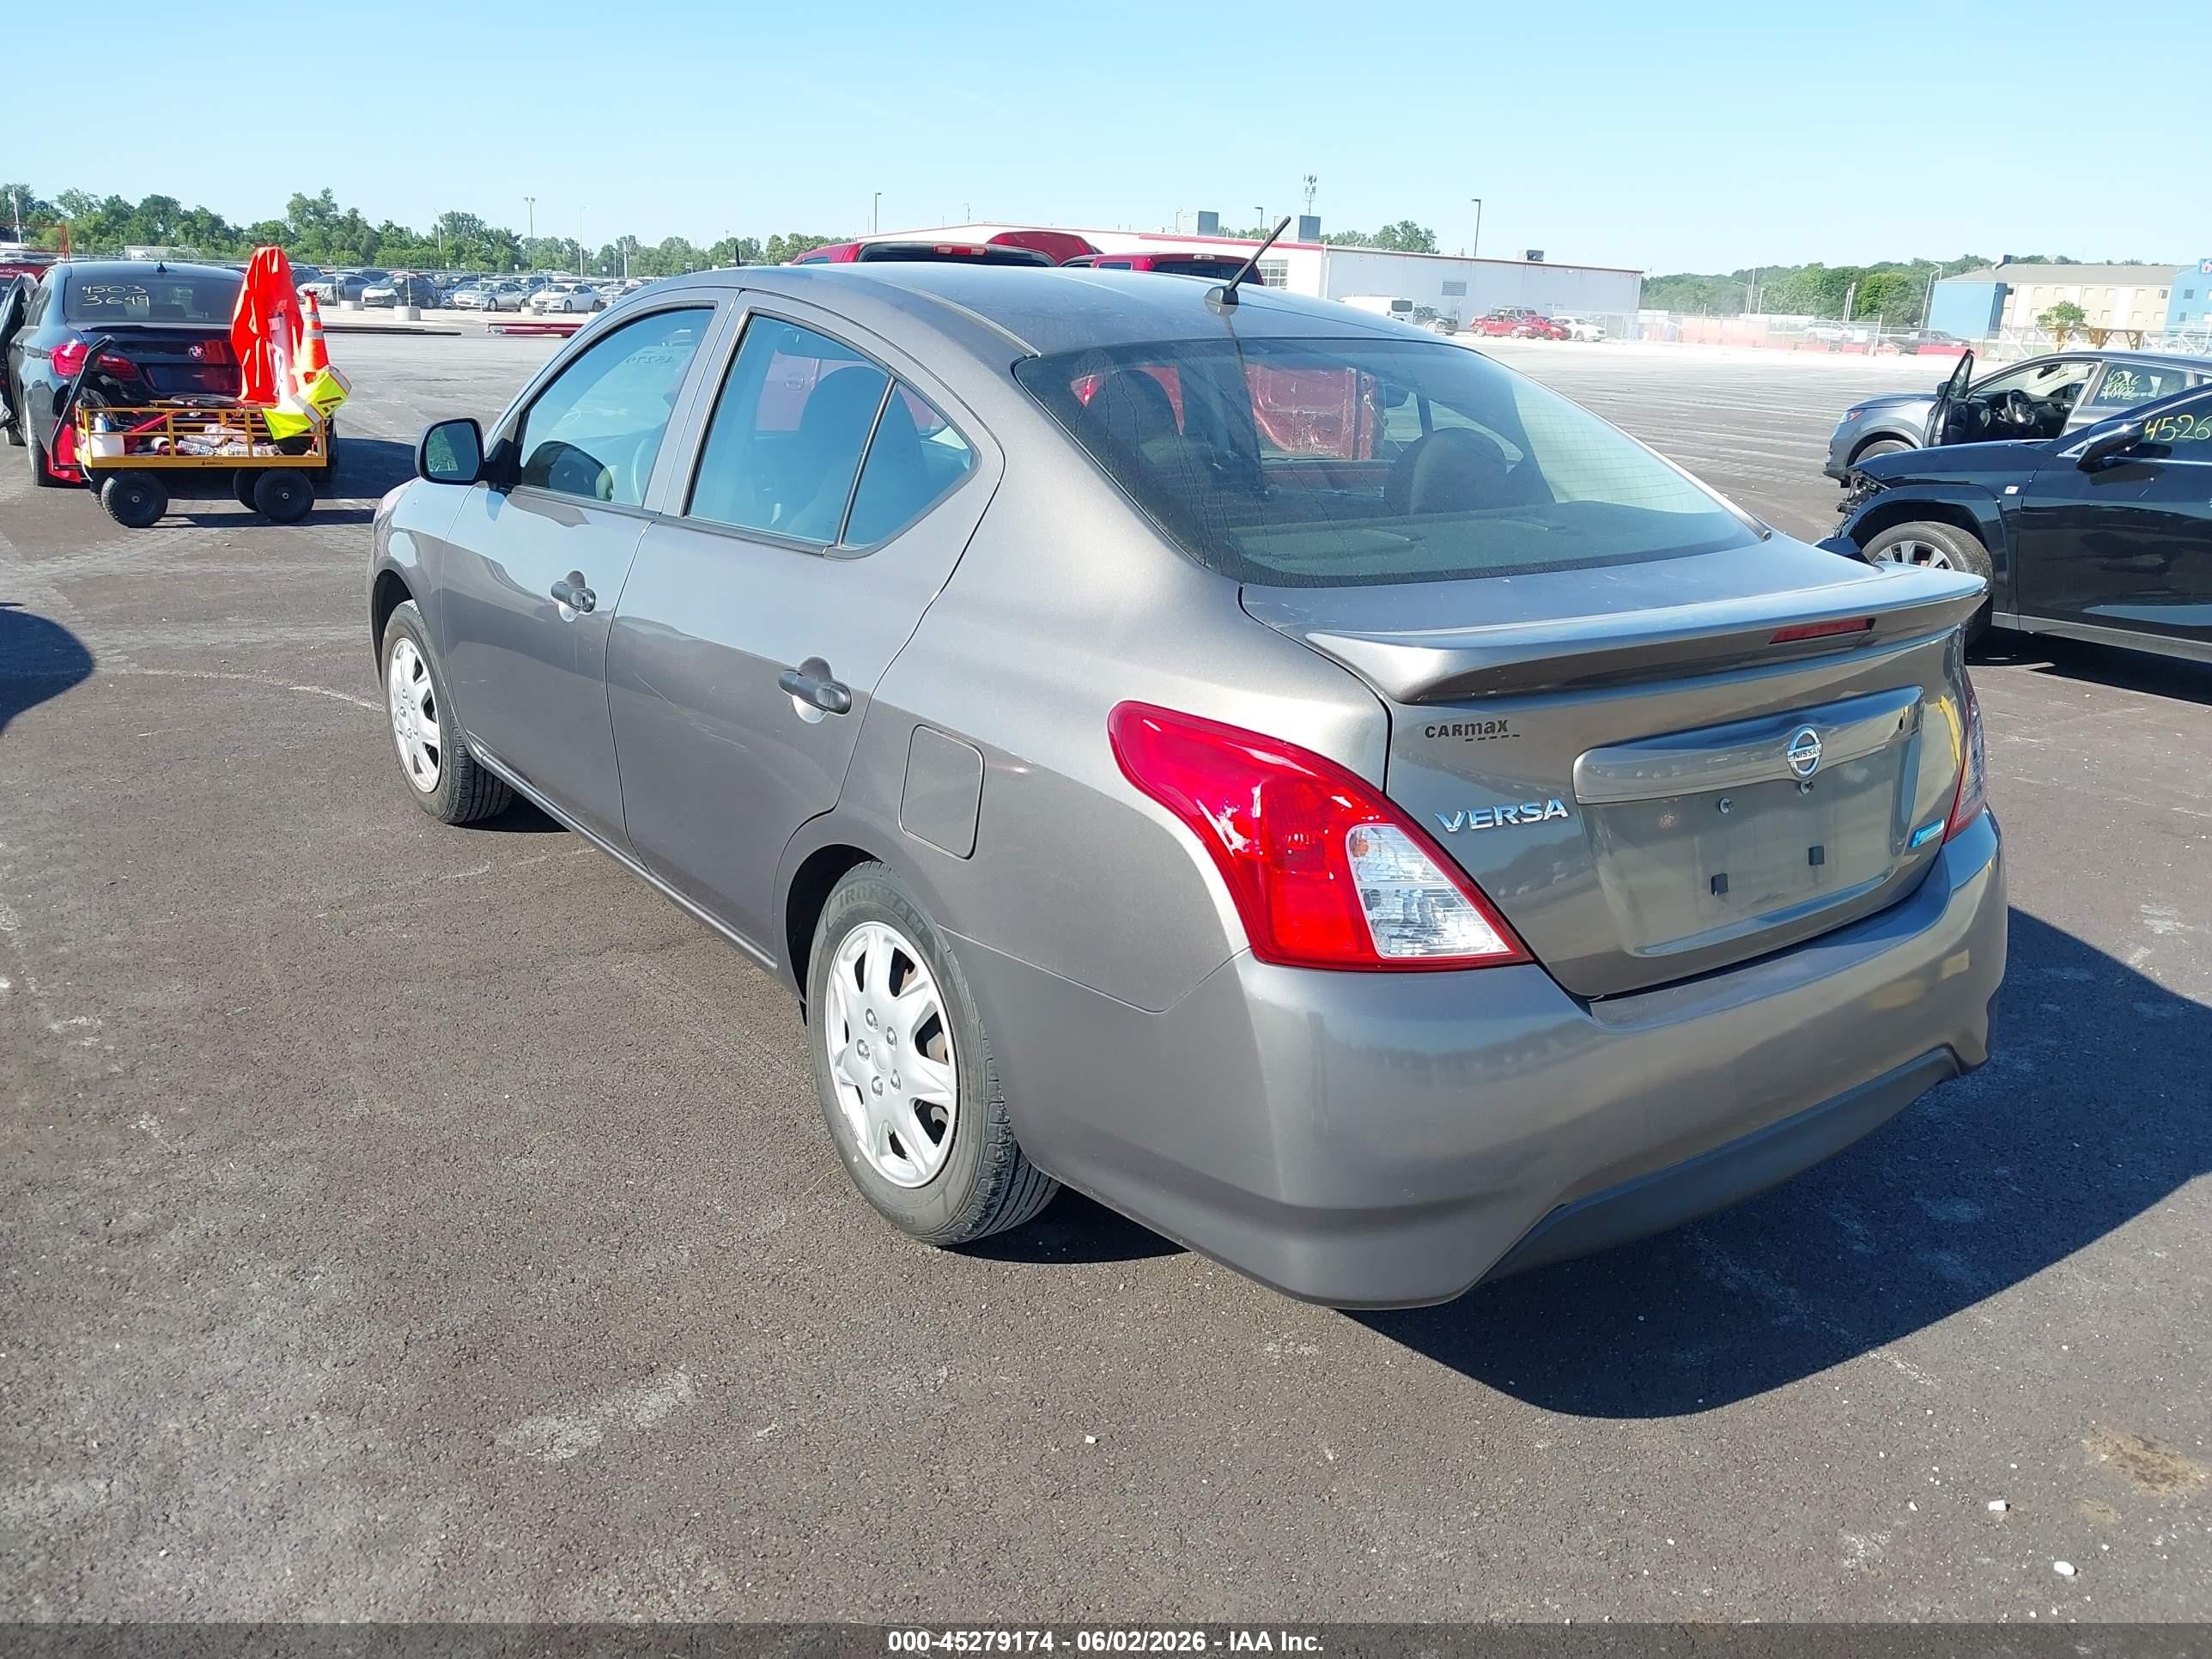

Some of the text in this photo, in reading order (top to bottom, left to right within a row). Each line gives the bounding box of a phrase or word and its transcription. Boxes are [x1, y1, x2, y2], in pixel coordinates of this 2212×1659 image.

[82, 285, 147, 295] 4503
[82, 295, 149, 307] 3649
[1793, 746, 1821, 759] NISSAN
[1434, 798, 1570, 833] VERSA
[838, 883, 925, 935] IRONMAN
